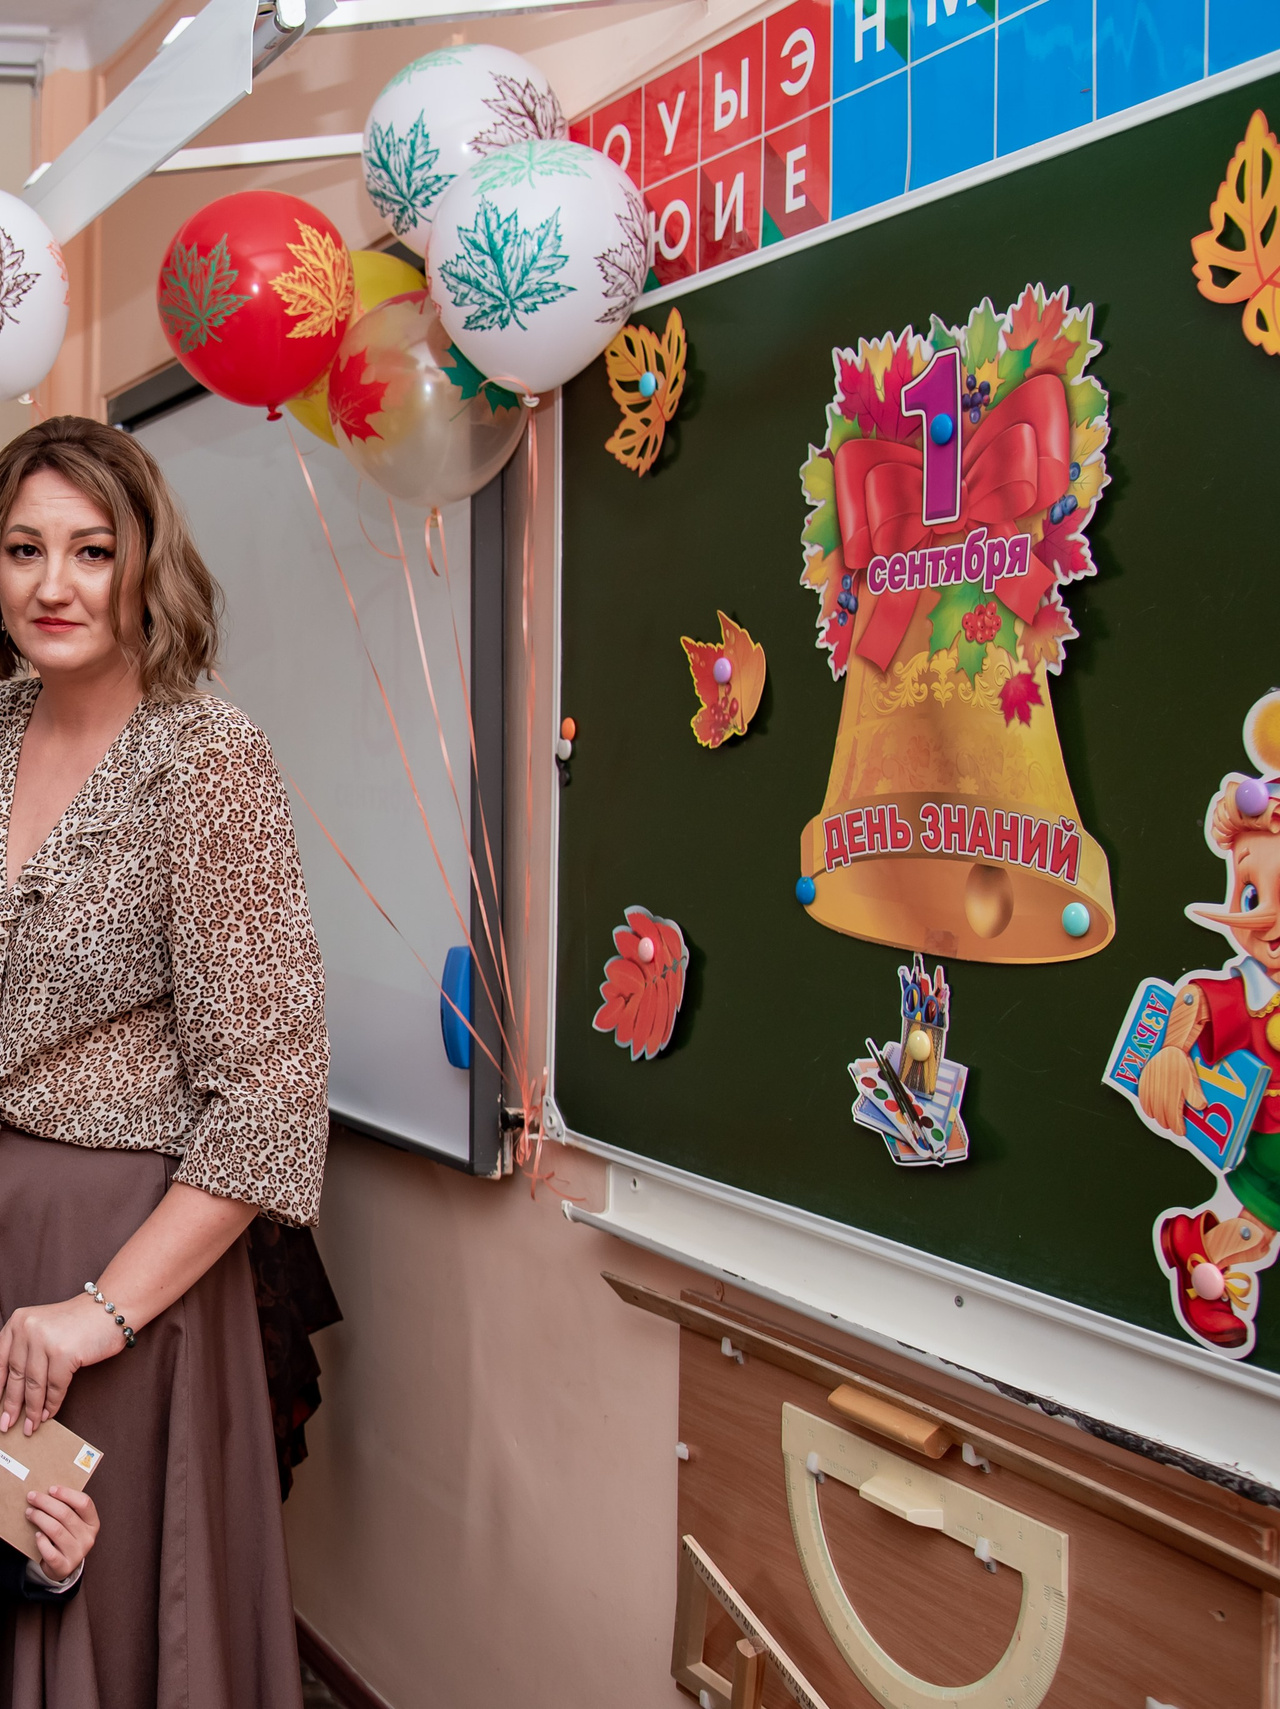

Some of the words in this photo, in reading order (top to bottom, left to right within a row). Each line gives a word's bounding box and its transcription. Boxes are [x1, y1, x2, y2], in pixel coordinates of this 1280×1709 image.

[714, 56, 749, 132] Ы
[780, 26, 816, 96] Э
[715, 171, 744, 241] И
[785, 144, 807, 214] Е
[901, 347, 962, 526] 1
[867, 527, 1031, 594] сентября
[823, 804, 912, 872] ДЕНЬ
[919, 801, 1082, 885] ЗНАНИЙ
[1115, 993, 1170, 1085] АЗБУКА
